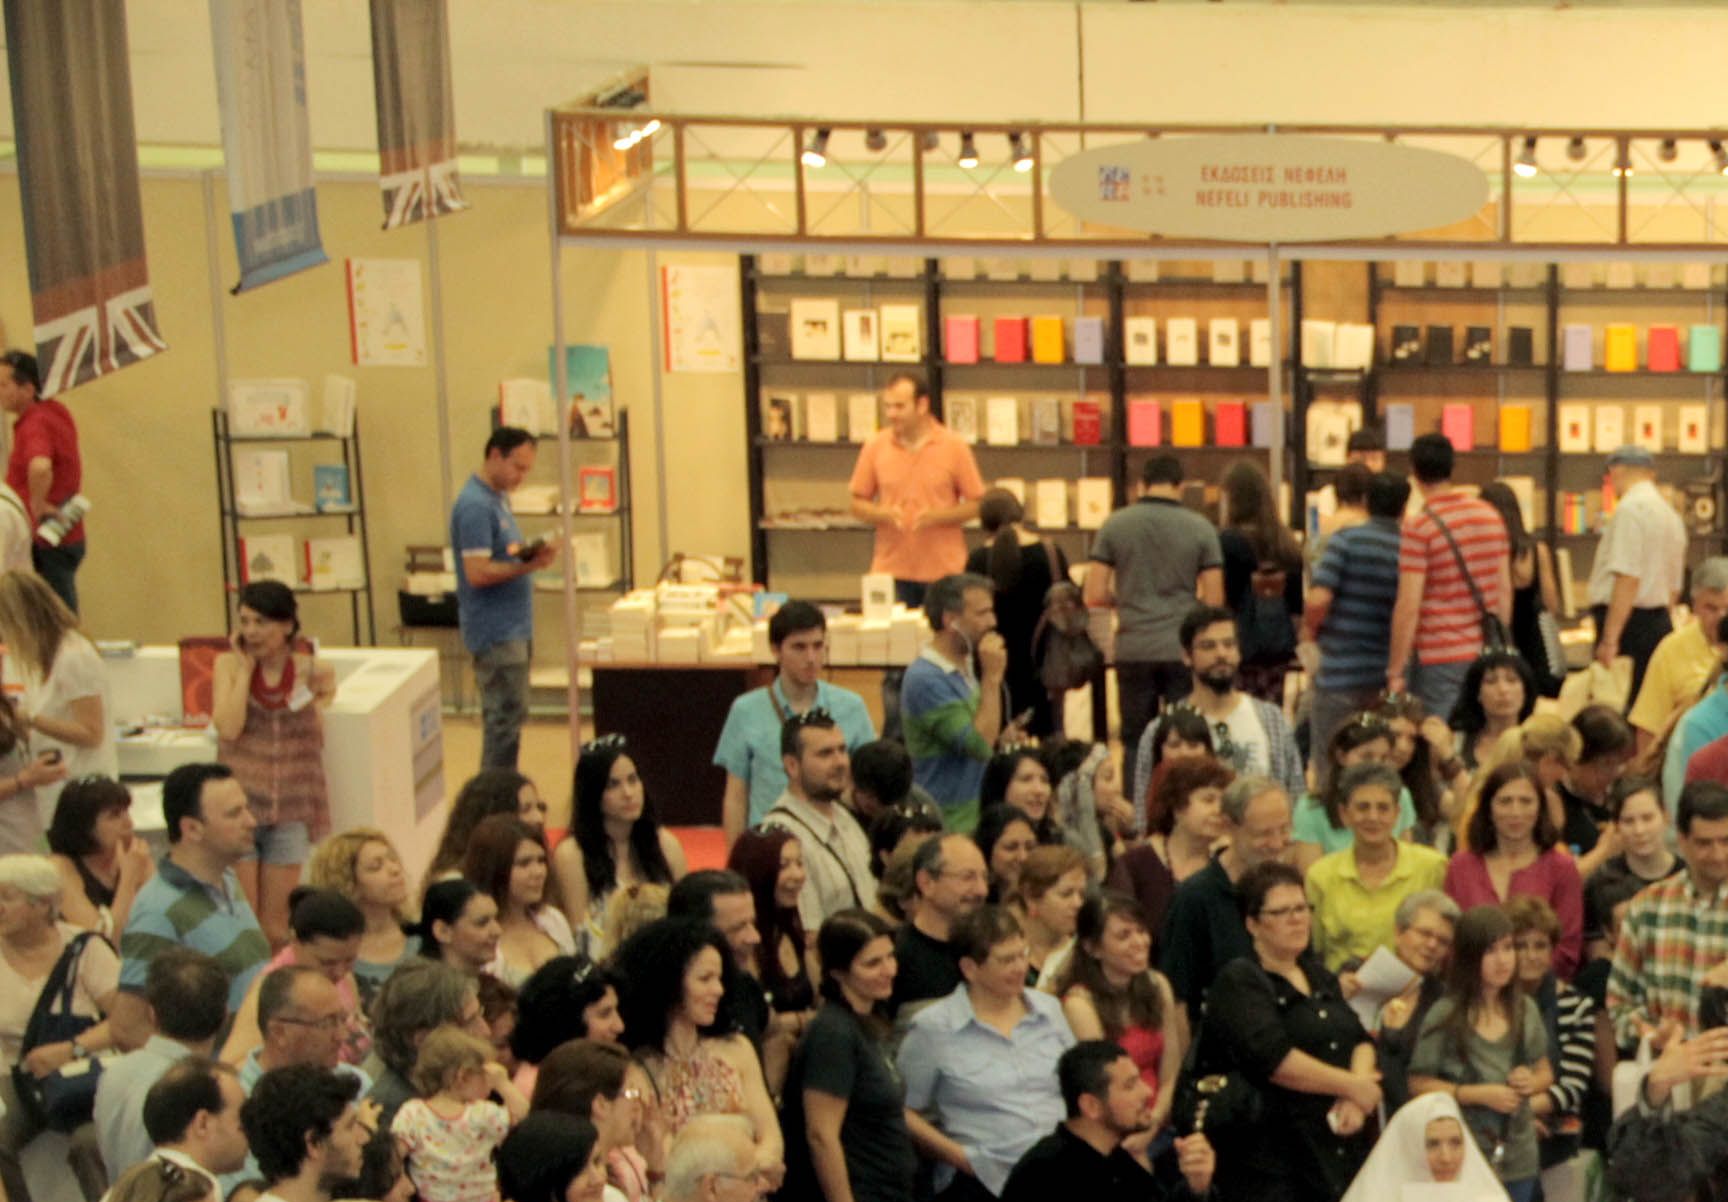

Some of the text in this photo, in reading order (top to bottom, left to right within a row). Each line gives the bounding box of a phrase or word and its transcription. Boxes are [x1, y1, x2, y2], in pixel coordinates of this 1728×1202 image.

[1200, 164, 1347, 184] ΕΚΔΟΣΕΙΣ ΝΕΦΕΛΗ
[1195, 190, 1353, 209] NEFELI PUBLISHING
